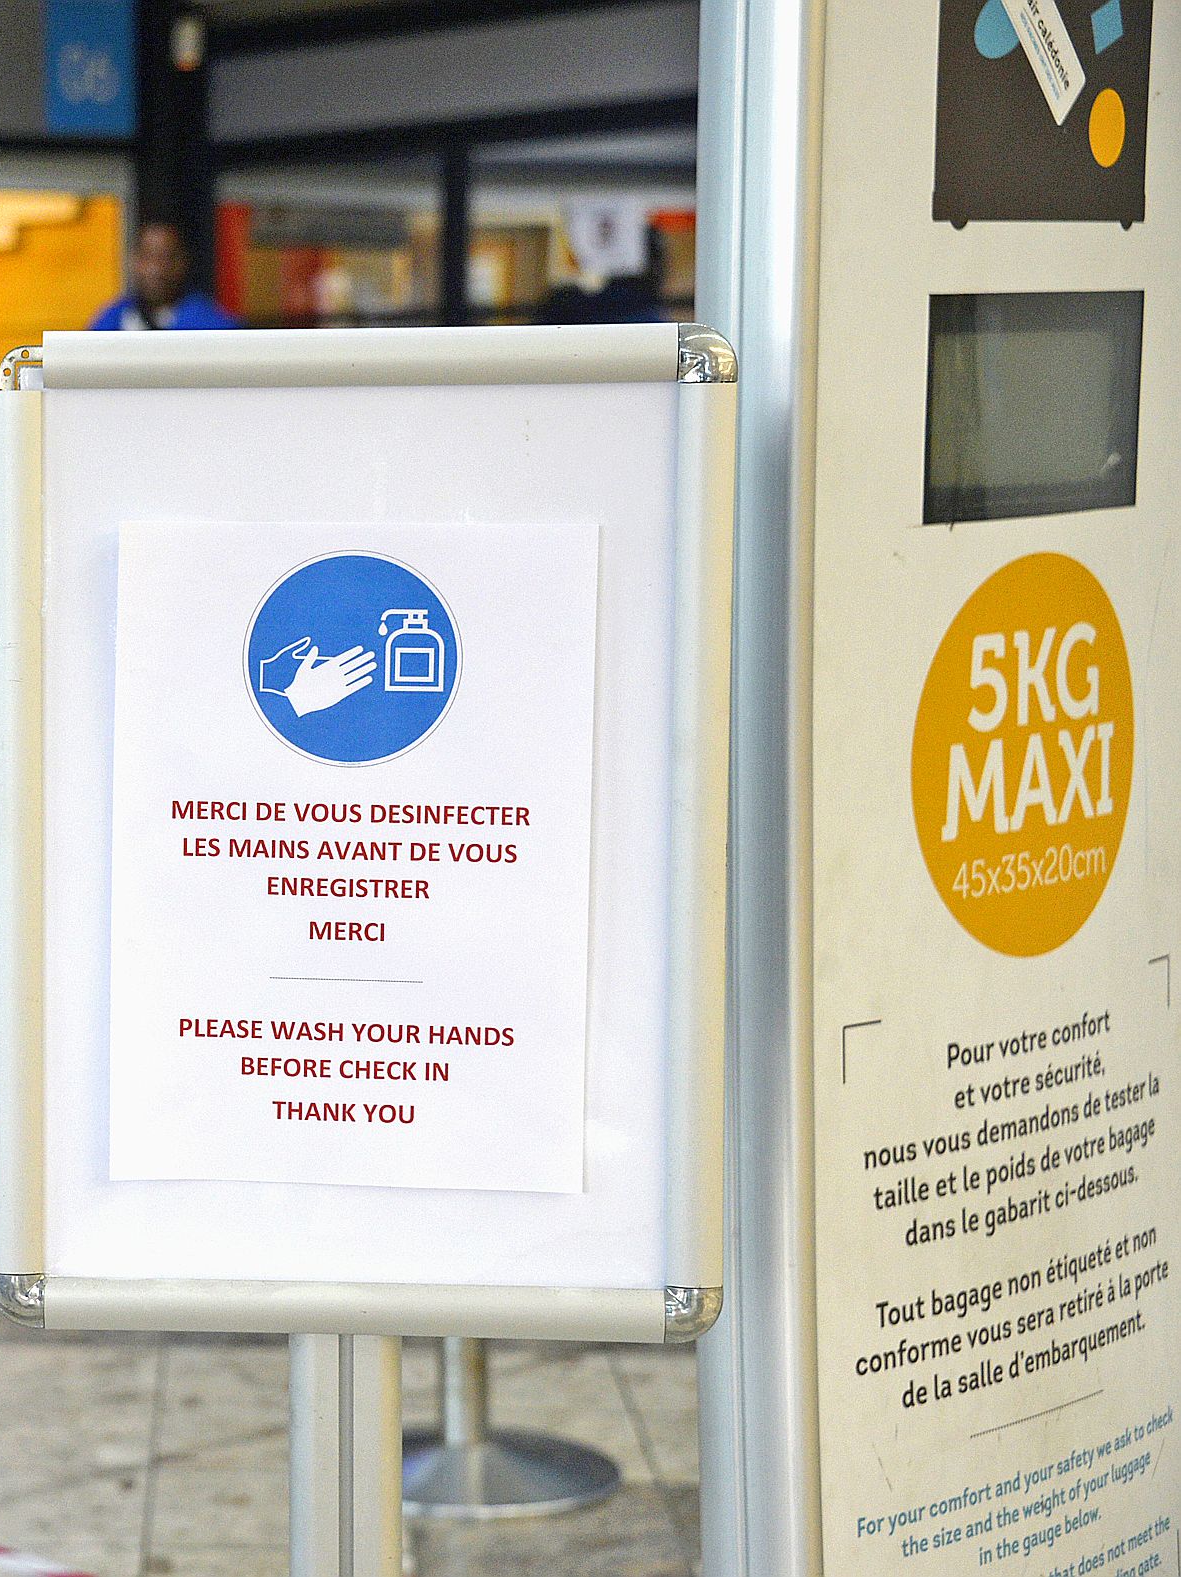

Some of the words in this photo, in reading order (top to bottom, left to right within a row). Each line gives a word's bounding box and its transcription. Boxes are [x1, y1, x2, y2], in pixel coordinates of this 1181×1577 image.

[1038, 19, 1070, 91] calédonie
[967, 621, 1100, 732] 5KG
[941, 721, 1114, 842] MAXI
[172, 801, 246, 820] MERCI
[256, 803, 285, 821] DE
[294, 803, 361, 823] VOUS
[371, 805, 530, 826] DESINFECTER
[183, 838, 220, 857] LES
[229, 839, 309, 859] MAINS
[317, 841, 402, 860] AVANT
[411, 843, 440, 861] DE
[448, 844, 517, 863] VOUS
[952, 844, 1107, 900] 45x35x20cm
[268, 877, 429, 899] ENREGISTRER
[310, 921, 384, 941] MERCI
[180, 1019, 262, 1038] PLEASE
[271, 1021, 343, 1041] WASH
[352, 1024, 420, 1043] YOUR
[429, 1026, 514, 1046] HANDS
[946, 1041, 996, 1070] Pour
[998, 1030, 1048, 1059] votre
[1051, 1010, 1111, 1047] confort
[242, 1057, 331, 1078] BEFORE
[340, 1060, 416, 1080] CHECK
[425, 1063, 448, 1081] IN
[953, 1083, 976, 1110] et
[979, 1075, 1031, 1104] votre
[1034, 1050, 1106, 1092] sécurité,
[272, 1101, 355, 1122] THANK
[363, 1104, 414, 1124] YOU
[863, 1141, 918, 1171] nous
[921, 1130, 972, 1158] vous
[976, 1103, 1080, 1147] demandons
[1082, 1091, 1102, 1120] de
[1104, 1081, 1147, 1113] tester
[1148, 1071, 1160, 1097] la
[872, 1175, 930, 1211] taille
[935, 1171, 958, 1198] et
[962, 1164, 981, 1193] le
[985, 1151, 1036, 1196] poids
[1040, 1144, 1061, 1173] de
[1063, 1136, 1106, 1165] votre
[1108, 1117, 1156, 1154] bagage
[904, 1217, 957, 1248] dans
[961, 1206, 980, 1235] le
[984, 1189, 1051, 1238] gabarit
[1054, 1165, 1139, 1210] ci-dessous.
[875, 1295, 926, 1329] Tout
[931, 1280, 1003, 1319] bagage
[1007, 1269, 1042, 1297] non
[1045, 1238, 1113, 1285] étiqueté
[1114, 1234, 1130, 1260] et
[1132, 1226, 1157, 1253] non
[854, 1333, 963, 1377] conforme
[966, 1320, 1013, 1349] vous
[1016, 1306, 1056, 1336] sera
[1058, 1282, 1104, 1322] retiré
[1106, 1278, 1116, 1304] à
[1118, 1273, 1132, 1299] la
[1134, 1260, 1169, 1301] porte
[901, 1379, 928, 1410] de
[933, 1373, 953, 1402] la
[957, 1358, 1004, 1395] salle
[1009, 1312, 1145, 1379] d'embarquement.
[857, 1516, 885, 1538] For
[887, 1505, 926, 1536] your
[929, 1483, 992, 1518] comfort
[995, 1470, 1021, 1498] and
[1023, 1464, 1055, 1494] your
[1056, 1449, 1095, 1476] safety
[1096, 1441, 1112, 1458] we
[1114, 1427, 1132, 1452] ask
[1133, 1425, 1145, 1442] to
[1147, 1404, 1173, 1435] check
[901, 1535, 929, 1558] the
[932, 1527, 962, 1549] size
[965, 1511, 993, 1539] and
[996, 1506, 1020, 1529] the
[1022, 1489, 1066, 1519] weight
[1068, 1478, 1082, 1501] of
[1083, 1472, 1110, 1502] your
[1111, 1452, 1151, 1484] luggage
[979, 1546, 993, 1566] in
[995, 1538, 1020, 1560] the
[1022, 1523, 1062, 1557] gauge
[1064, 1507, 1102, 1535] below.
[1078, 1552, 1105, 1577] does
[1107, 1541, 1126, 1562] not
[1127, 1526, 1153, 1551] meet
[1154, 1517, 1170, 1537] the
